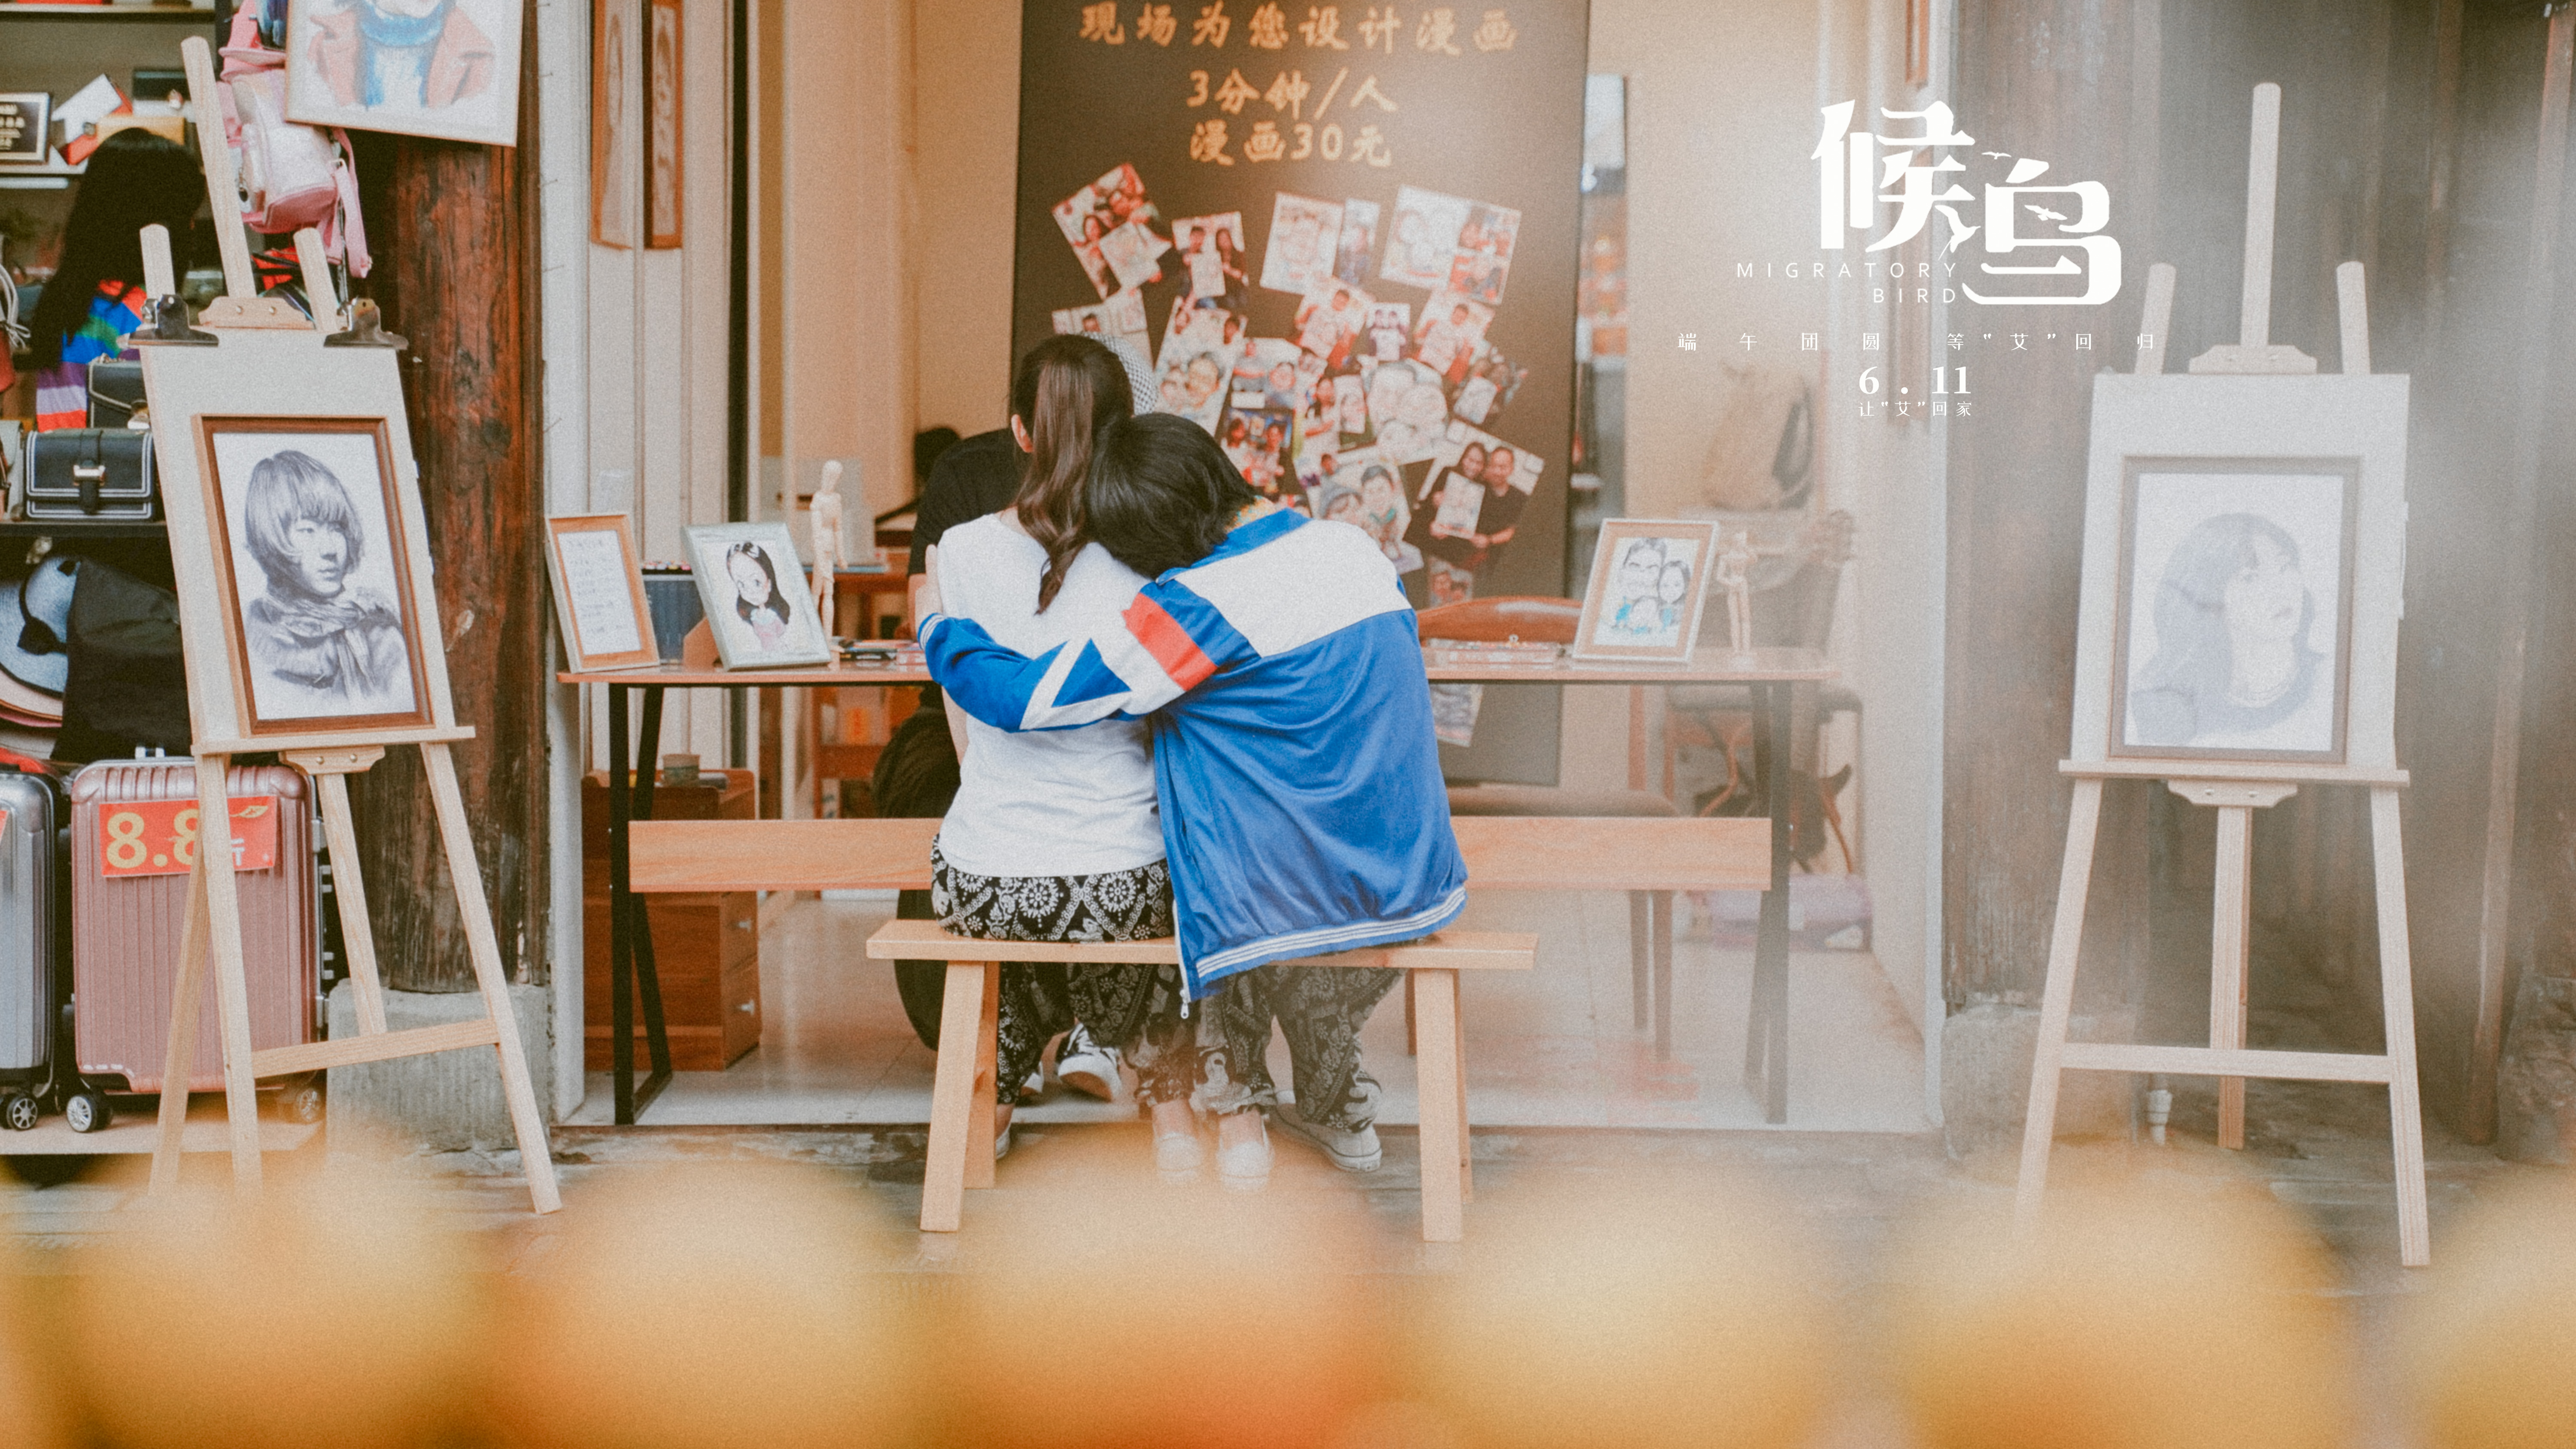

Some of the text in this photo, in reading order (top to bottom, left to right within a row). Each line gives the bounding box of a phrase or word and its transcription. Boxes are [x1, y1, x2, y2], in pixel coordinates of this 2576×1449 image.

[1079, 1, 1519, 57] 现场为您设计漫画
[1186, 67, 1398, 121] 3分钟/人
[1189, 118, 1392, 167] 漫画30元
